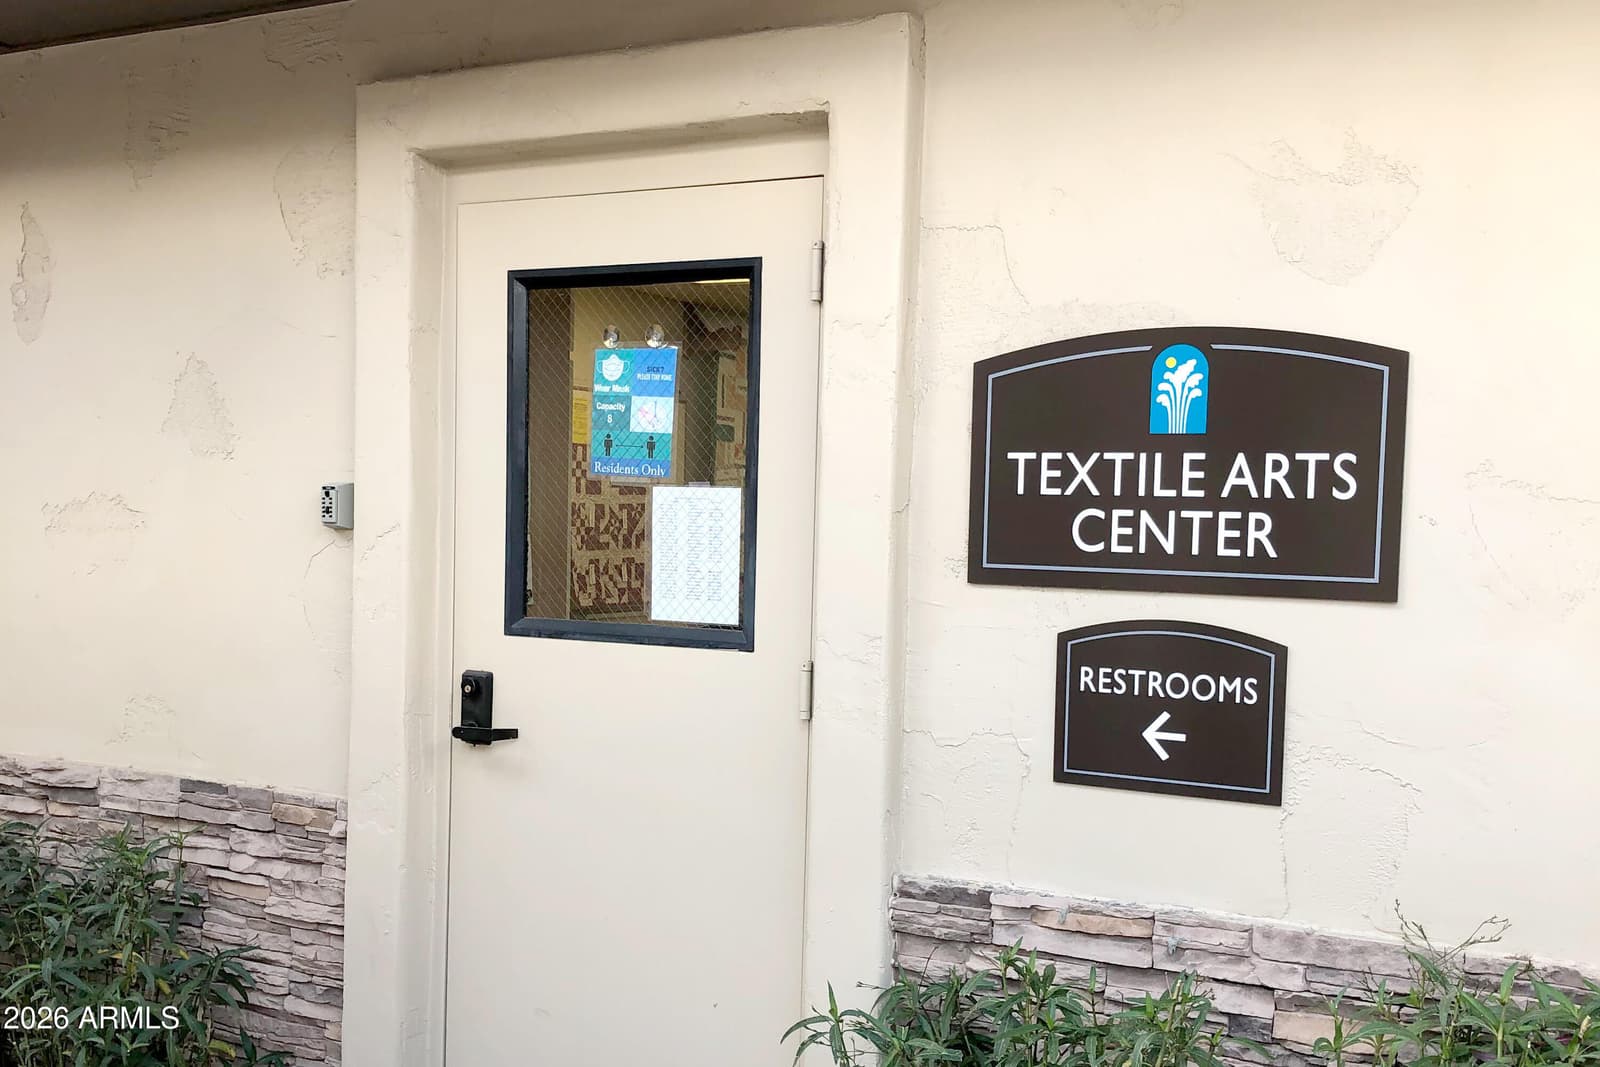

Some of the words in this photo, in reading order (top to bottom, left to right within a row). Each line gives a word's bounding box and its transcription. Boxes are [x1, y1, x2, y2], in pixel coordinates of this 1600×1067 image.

[594, 384, 611, 393] Wear
[612, 384, 630, 393] Mask
[596, 402, 625, 413] Capacity
[594, 461, 639, 475] Residents
[641, 463, 666, 478] Only
[1007, 452, 1206, 498] TEXTILE
[1220, 452, 1358, 501] ARTS
[1071, 508, 1278, 558] CENTER
[1079, 665, 1258, 705] RESTROOMS
